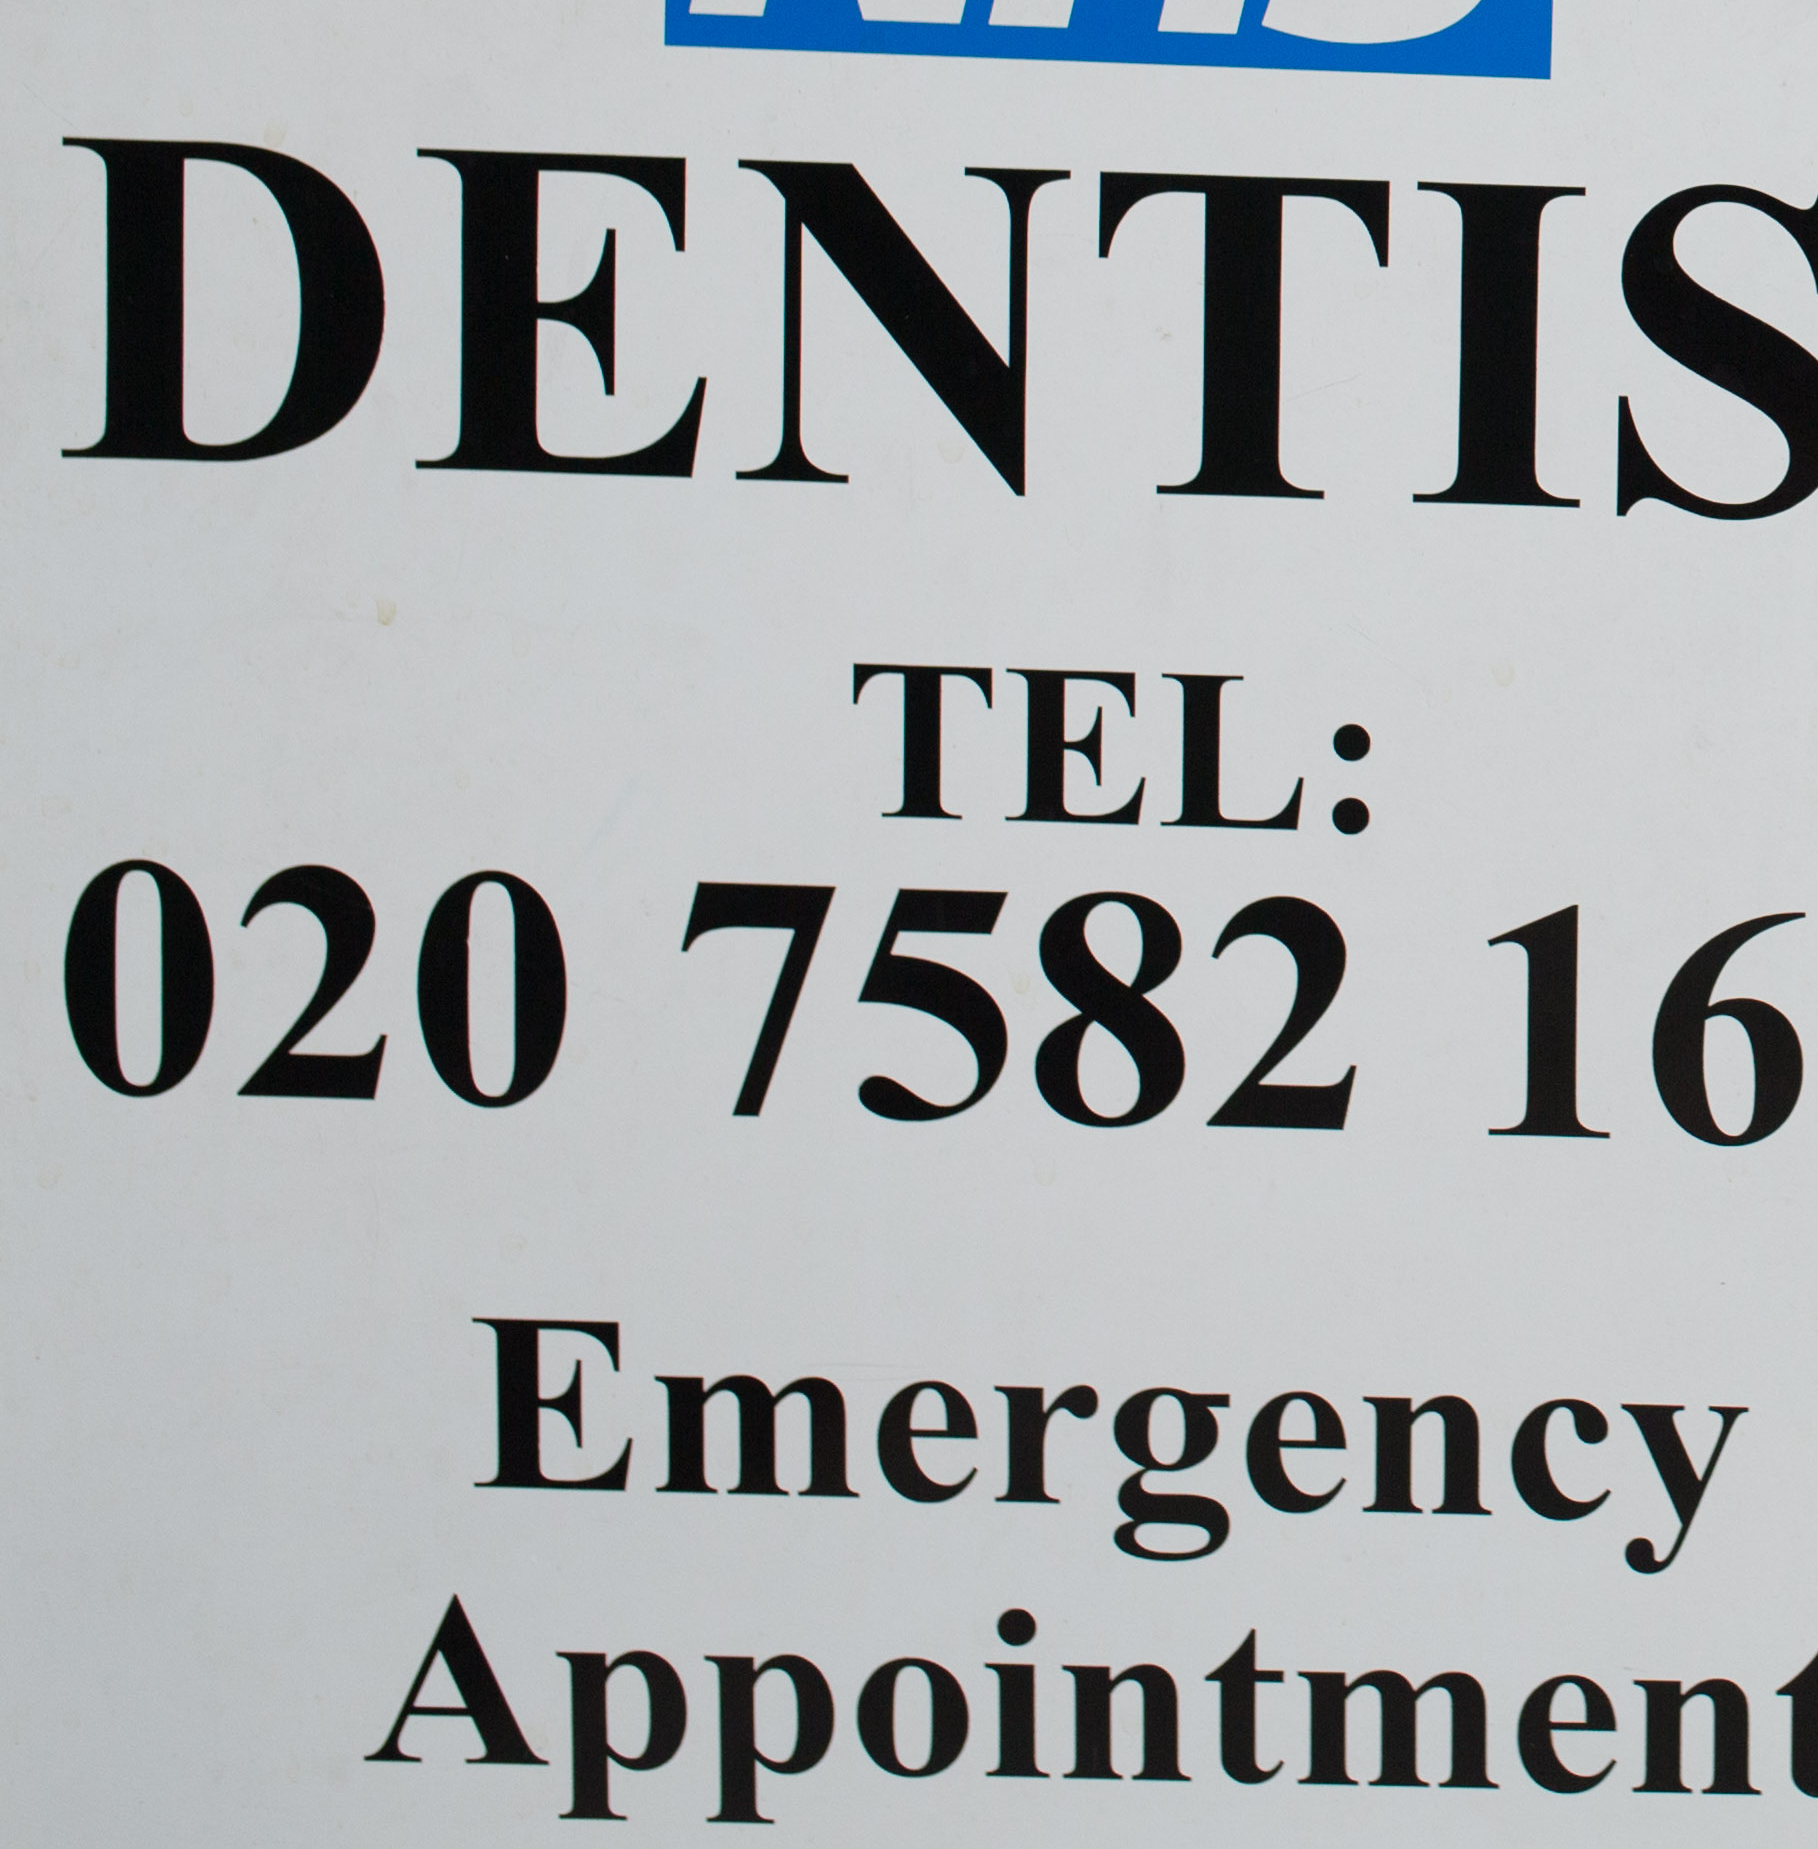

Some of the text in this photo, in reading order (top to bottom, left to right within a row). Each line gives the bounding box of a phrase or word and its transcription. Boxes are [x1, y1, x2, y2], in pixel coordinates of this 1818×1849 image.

[852, 662, 1372, 836] TEL:
[62, 858, 568, 1110] 020
[680, 880, 1358, 1132] 7582
[470, 1316, 1750, 1576] Emergency
